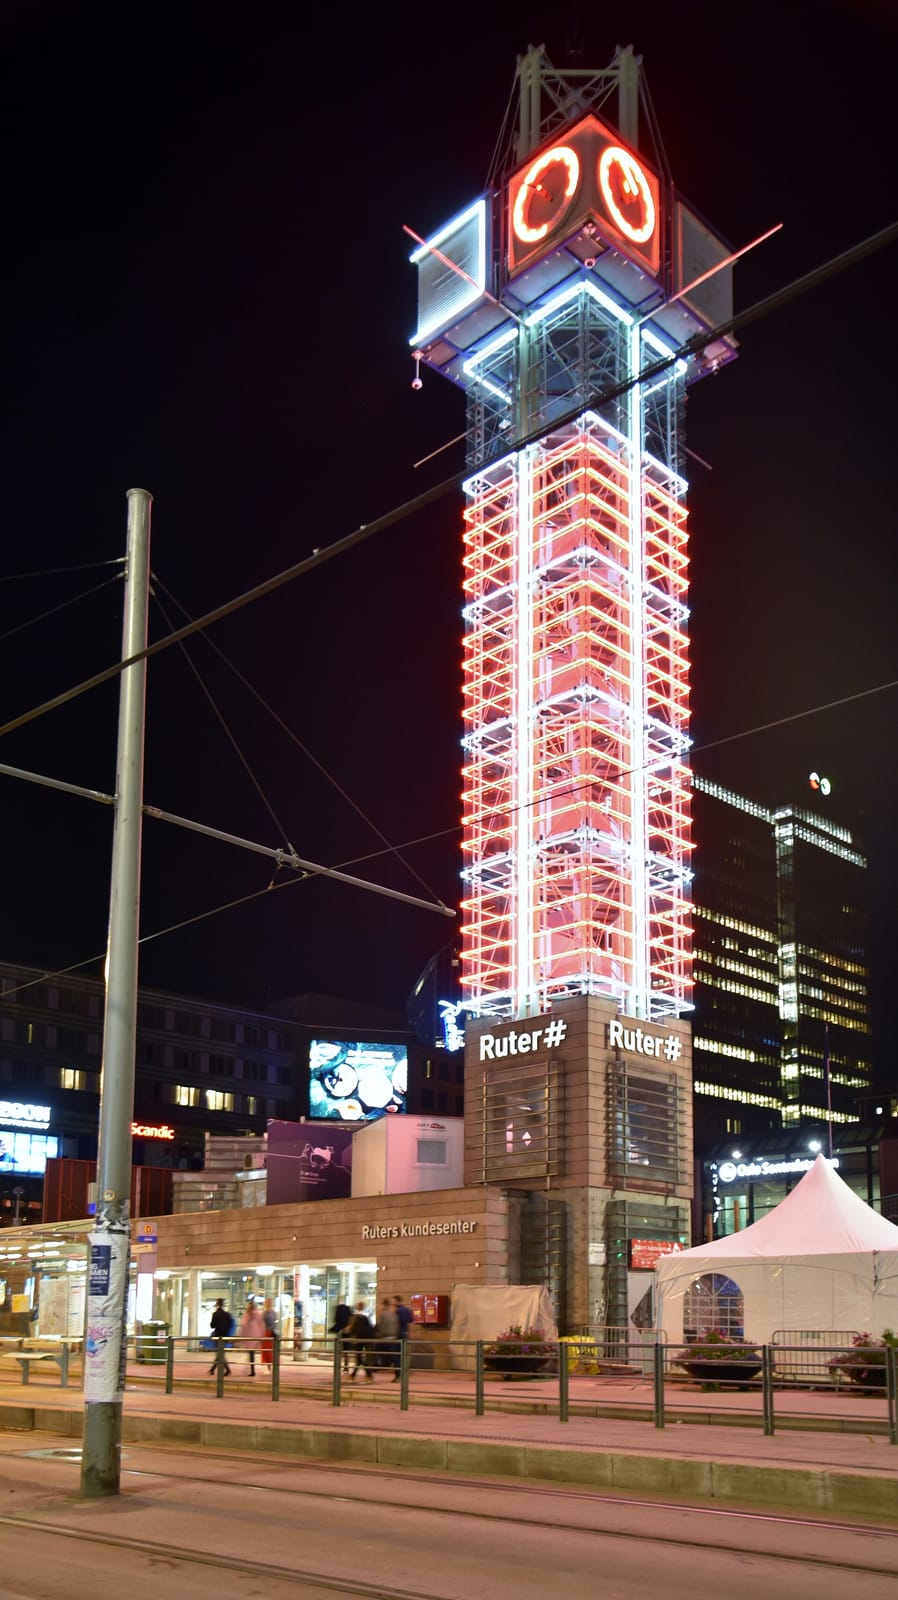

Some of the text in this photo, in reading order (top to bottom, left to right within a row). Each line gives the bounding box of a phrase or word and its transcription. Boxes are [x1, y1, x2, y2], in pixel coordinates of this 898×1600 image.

[479, 1019, 567, 1061] Ruter#
[609, 1019, 682, 1061] Ruter#
[130, 1122, 175, 1139] Scandic
[362, 1219, 476, 1240] Ruters kundesenter
